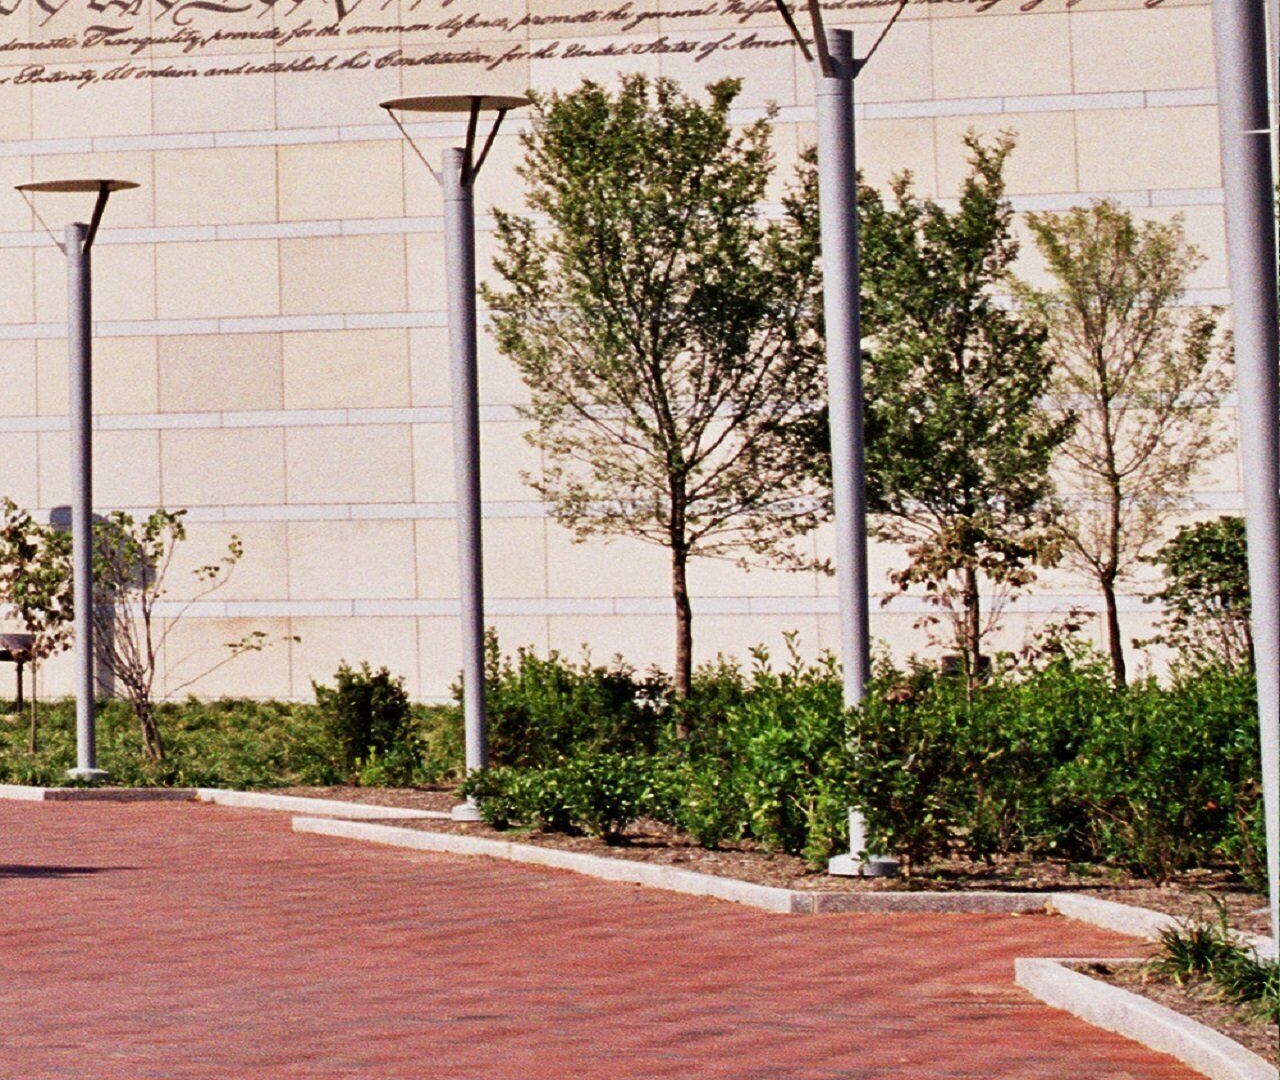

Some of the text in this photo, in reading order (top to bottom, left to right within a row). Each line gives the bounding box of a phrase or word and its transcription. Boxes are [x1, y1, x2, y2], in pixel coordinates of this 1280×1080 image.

[276, 19, 316, 47] for
[315, 23, 340, 37] the
[346, 23, 432, 38] common
[507, 11, 604, 32] promote
[598, 1, 634, 21] the
[621, 2, 719, 31] general
[102, 62, 146, 81] do
[135, 65, 197, 79] ordain
[204, 62, 251, 77] and
[244, 55, 338, 75] establish
[334, 51, 371, 71] this
[374, 49, 495, 71] Constitution
[486, 44, 531, 71] for
[528, 41, 560, 59] the
[561, 42, 632, 59] United
[631, 36, 700, 56] States
[695, 32, 736, 62] of
